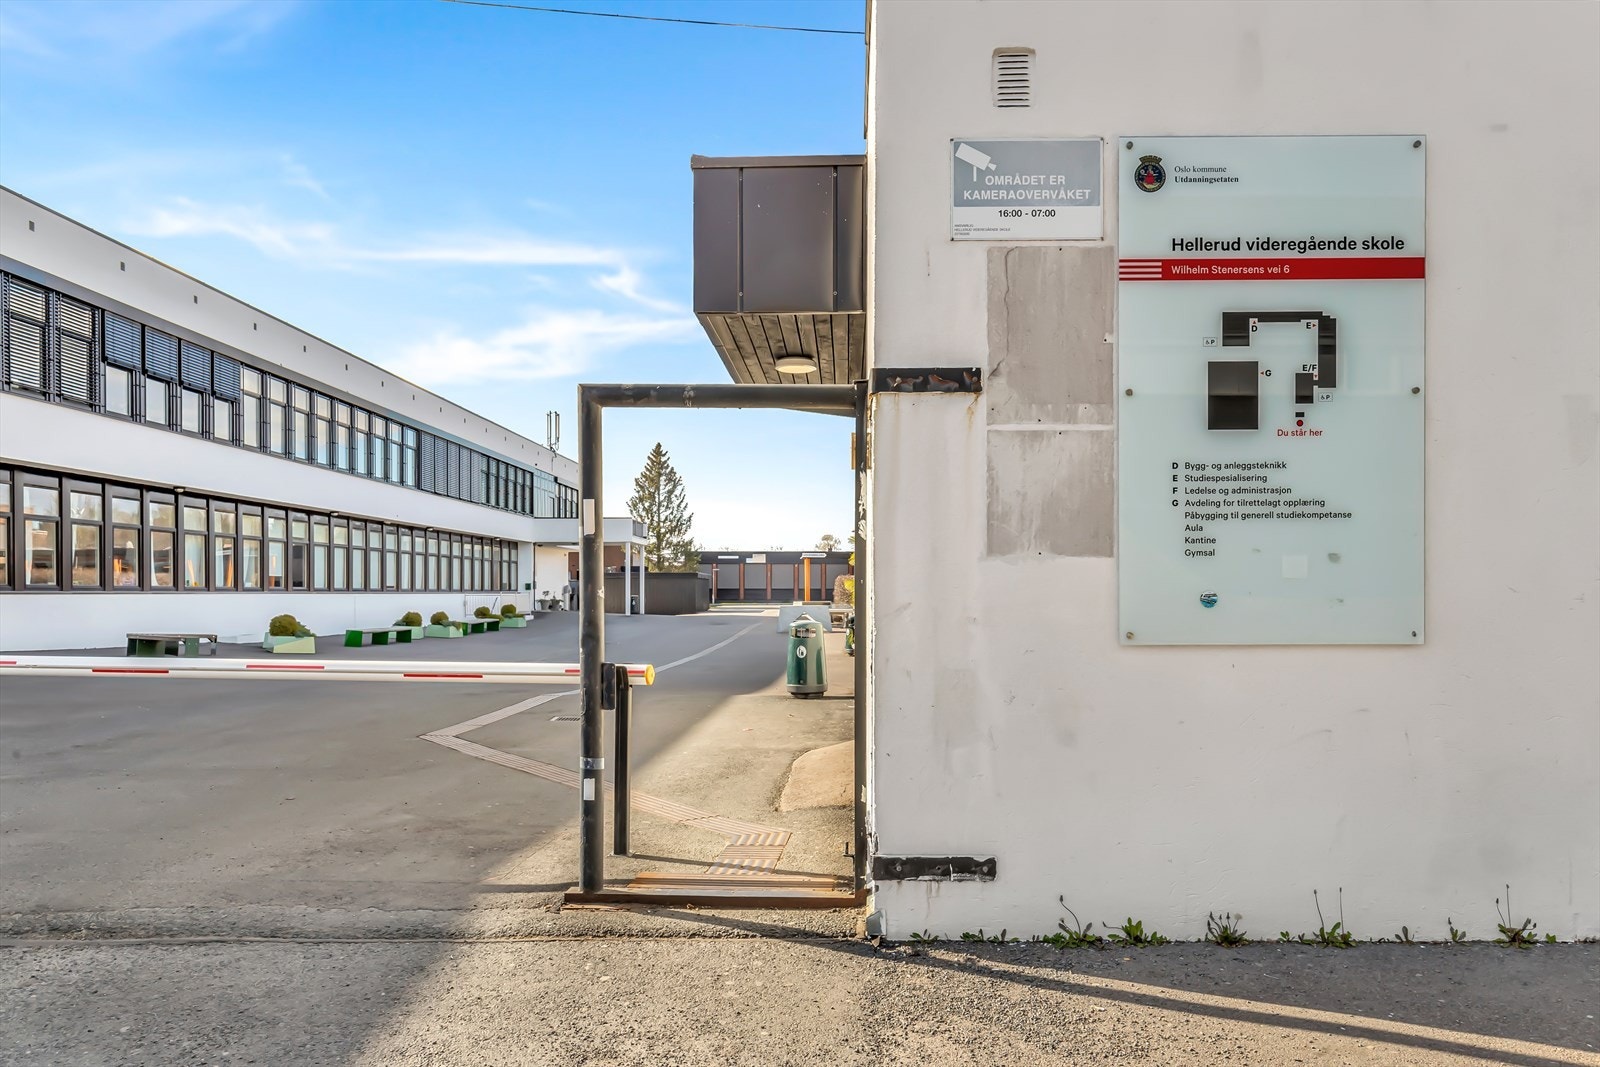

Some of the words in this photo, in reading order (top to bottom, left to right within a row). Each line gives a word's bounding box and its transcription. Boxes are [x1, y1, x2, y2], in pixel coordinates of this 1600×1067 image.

[1174, 165, 1191, 173] Oslo
[1192, 165, 1227, 173] kommune
[985, 173, 1046, 186] OMRÅDET
[1049, 175, 1066, 186] ER
[1174, 175, 1239, 184] Utdanningsetaten
[963, 187, 1091, 200] KAMERAOVERVÅKET
[998, 209, 1023, 218] 16:00
[1031, 209, 1056, 218] 07:00
[1171, 236, 1241, 252] Hellerud
[1245, 235, 1357, 254] videregående
[1361, 235, 1405, 251] skole
[1171, 265, 1209, 275] Wilhelm
[1211, 265, 1265, 275] Stenersens
[1267, 265, 1281, 274] vei
[1283, 265, 1290, 274] 6
[1302, 364, 1317, 372] E/F
[1277, 429, 1289, 437] Du
[1291, 427, 1308, 437] står
[1309, 428, 1323, 437] her
[1172, 462, 1179, 470] D
[1184, 461, 1210, 471] Bygg-
[1211, 463, 1222, 471] og
[1223, 461, 1287, 471] anleggsteknikk
[1172, 474, 1179, 482] E
[1184, 474, 1268, 484] Studiespesialisering
[1184, 486, 1217, 495] Ledelse
[1218, 488, 1229, 496] og
[1231, 486, 1292, 496] administrasjon
[1172, 499, 1179, 507] G
[1184, 499, 1221, 508] Avdeling
[1222, 499, 1235, 507] for
[1237, 499, 1281, 508] tilrettelagt
[1283, 499, 1326, 509] opplæring
[1184, 511, 1229, 521] Påbygging
[1230, 511, 1240, 519] til
[1240, 511, 1274, 521] generell
[1276, 511, 1352, 521] studiekompetanse
[1184, 524, 1204, 532] Aula
[1184, 536, 1217, 545] Kantine
[1184, 548, 1216, 558] Gymsal
